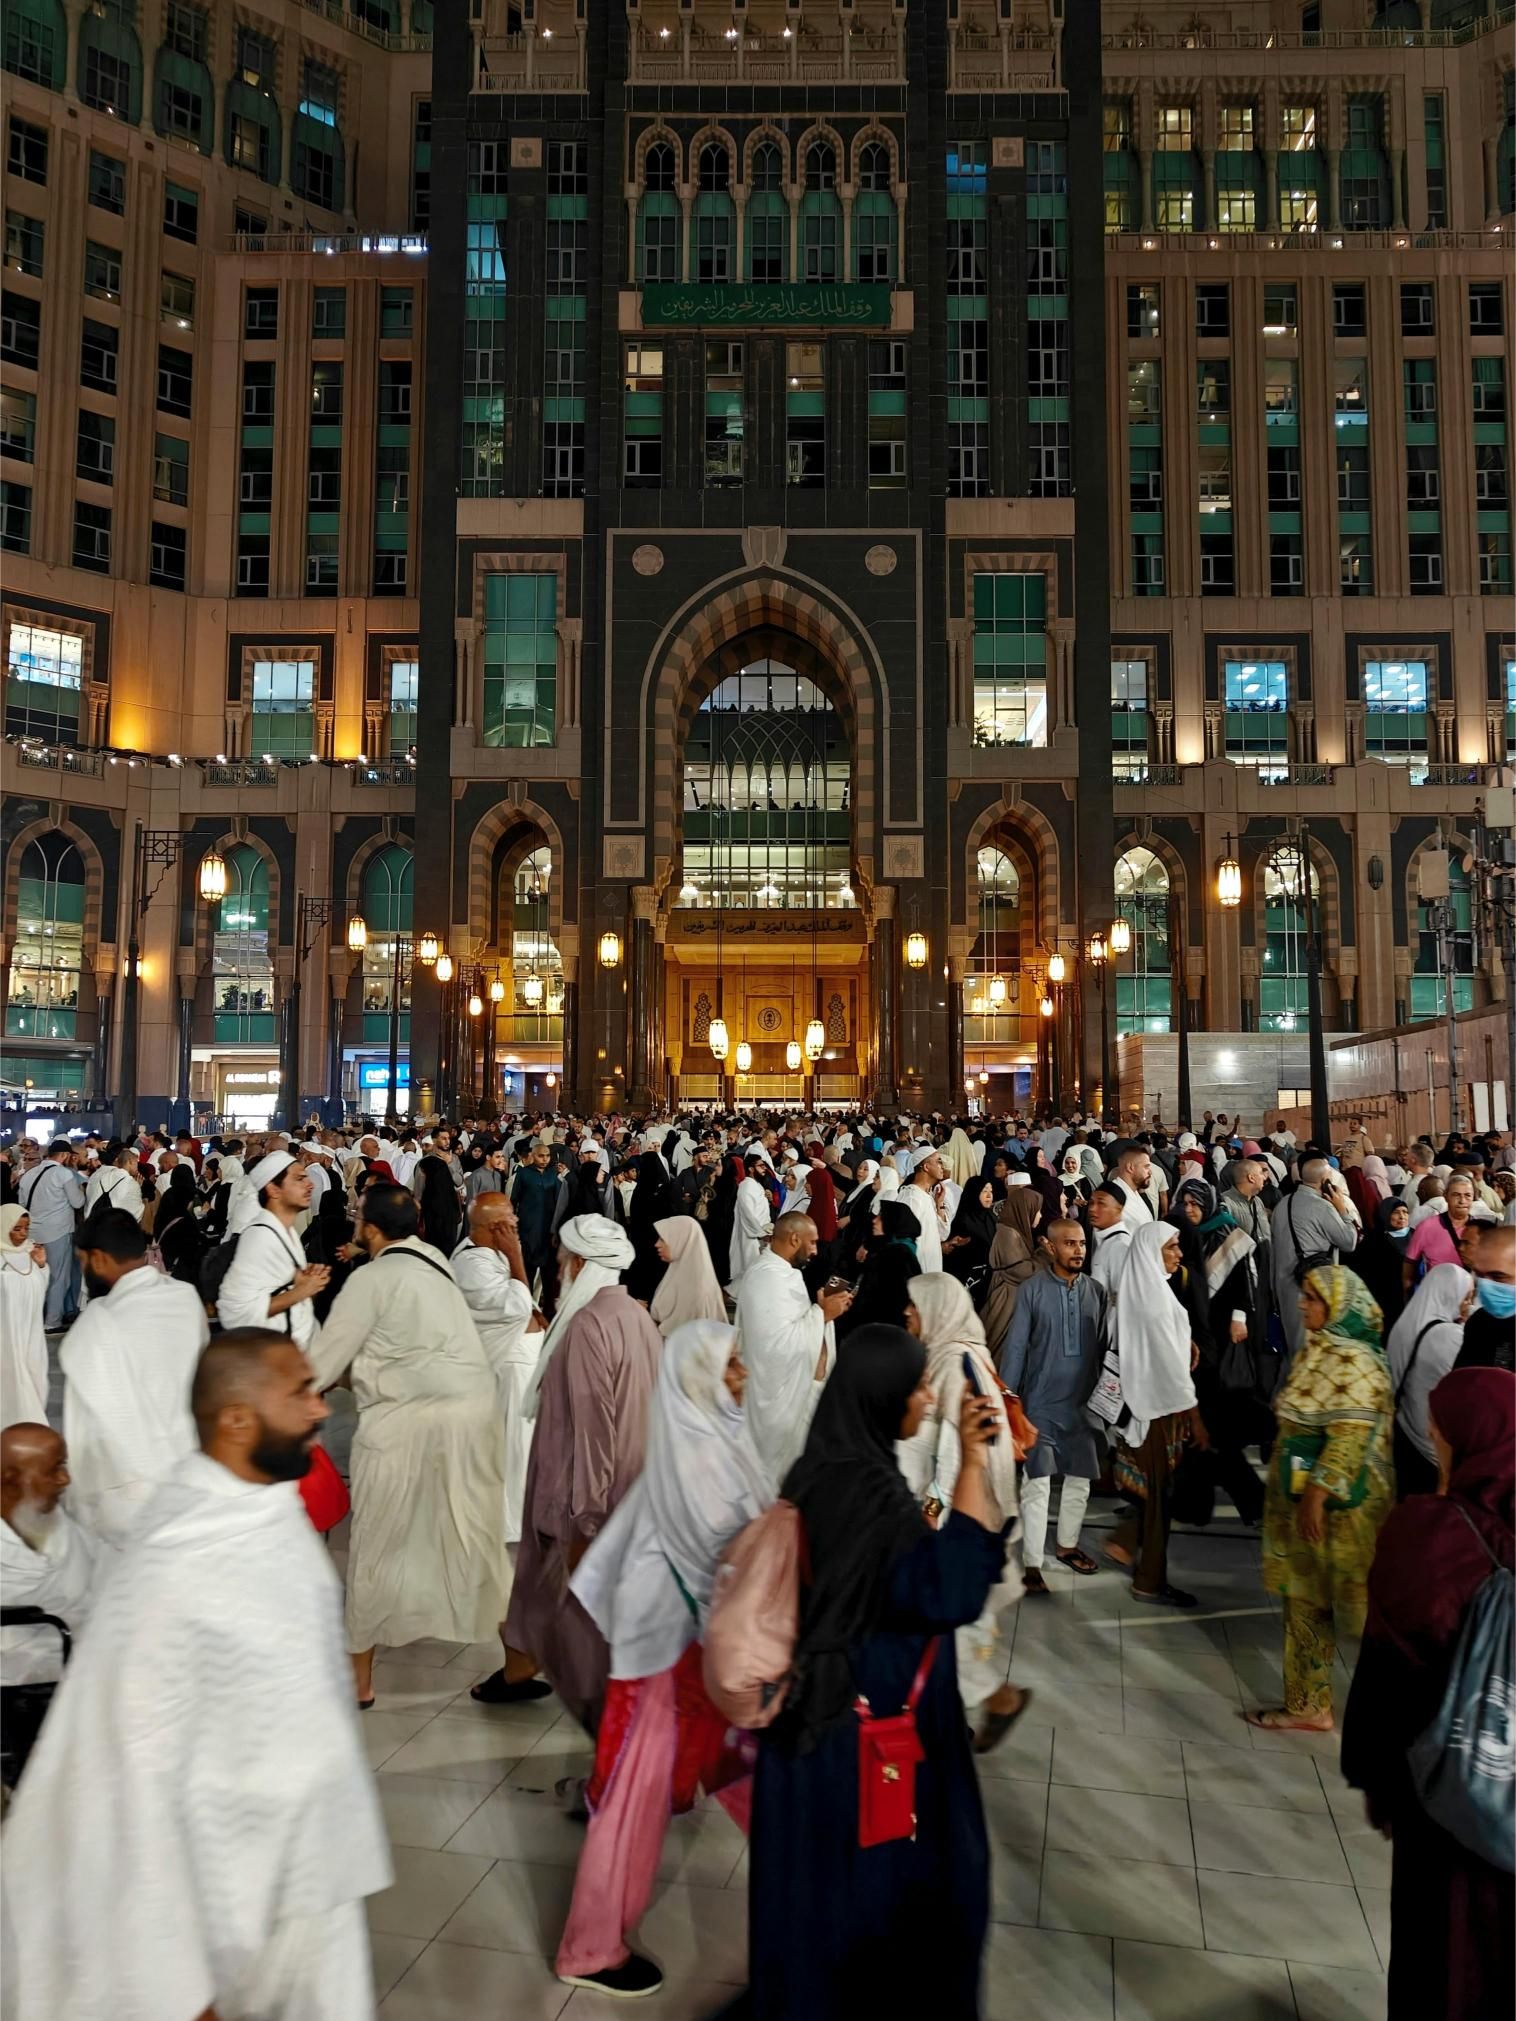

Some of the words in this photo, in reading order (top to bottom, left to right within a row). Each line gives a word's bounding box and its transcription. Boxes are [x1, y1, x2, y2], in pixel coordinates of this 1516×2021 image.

[660, 289, 724, 319] الشريفين
[707, 288, 755, 319] للحرمين
[808, 289, 847, 317] الملك
[837, 298, 873, 319] وقف
